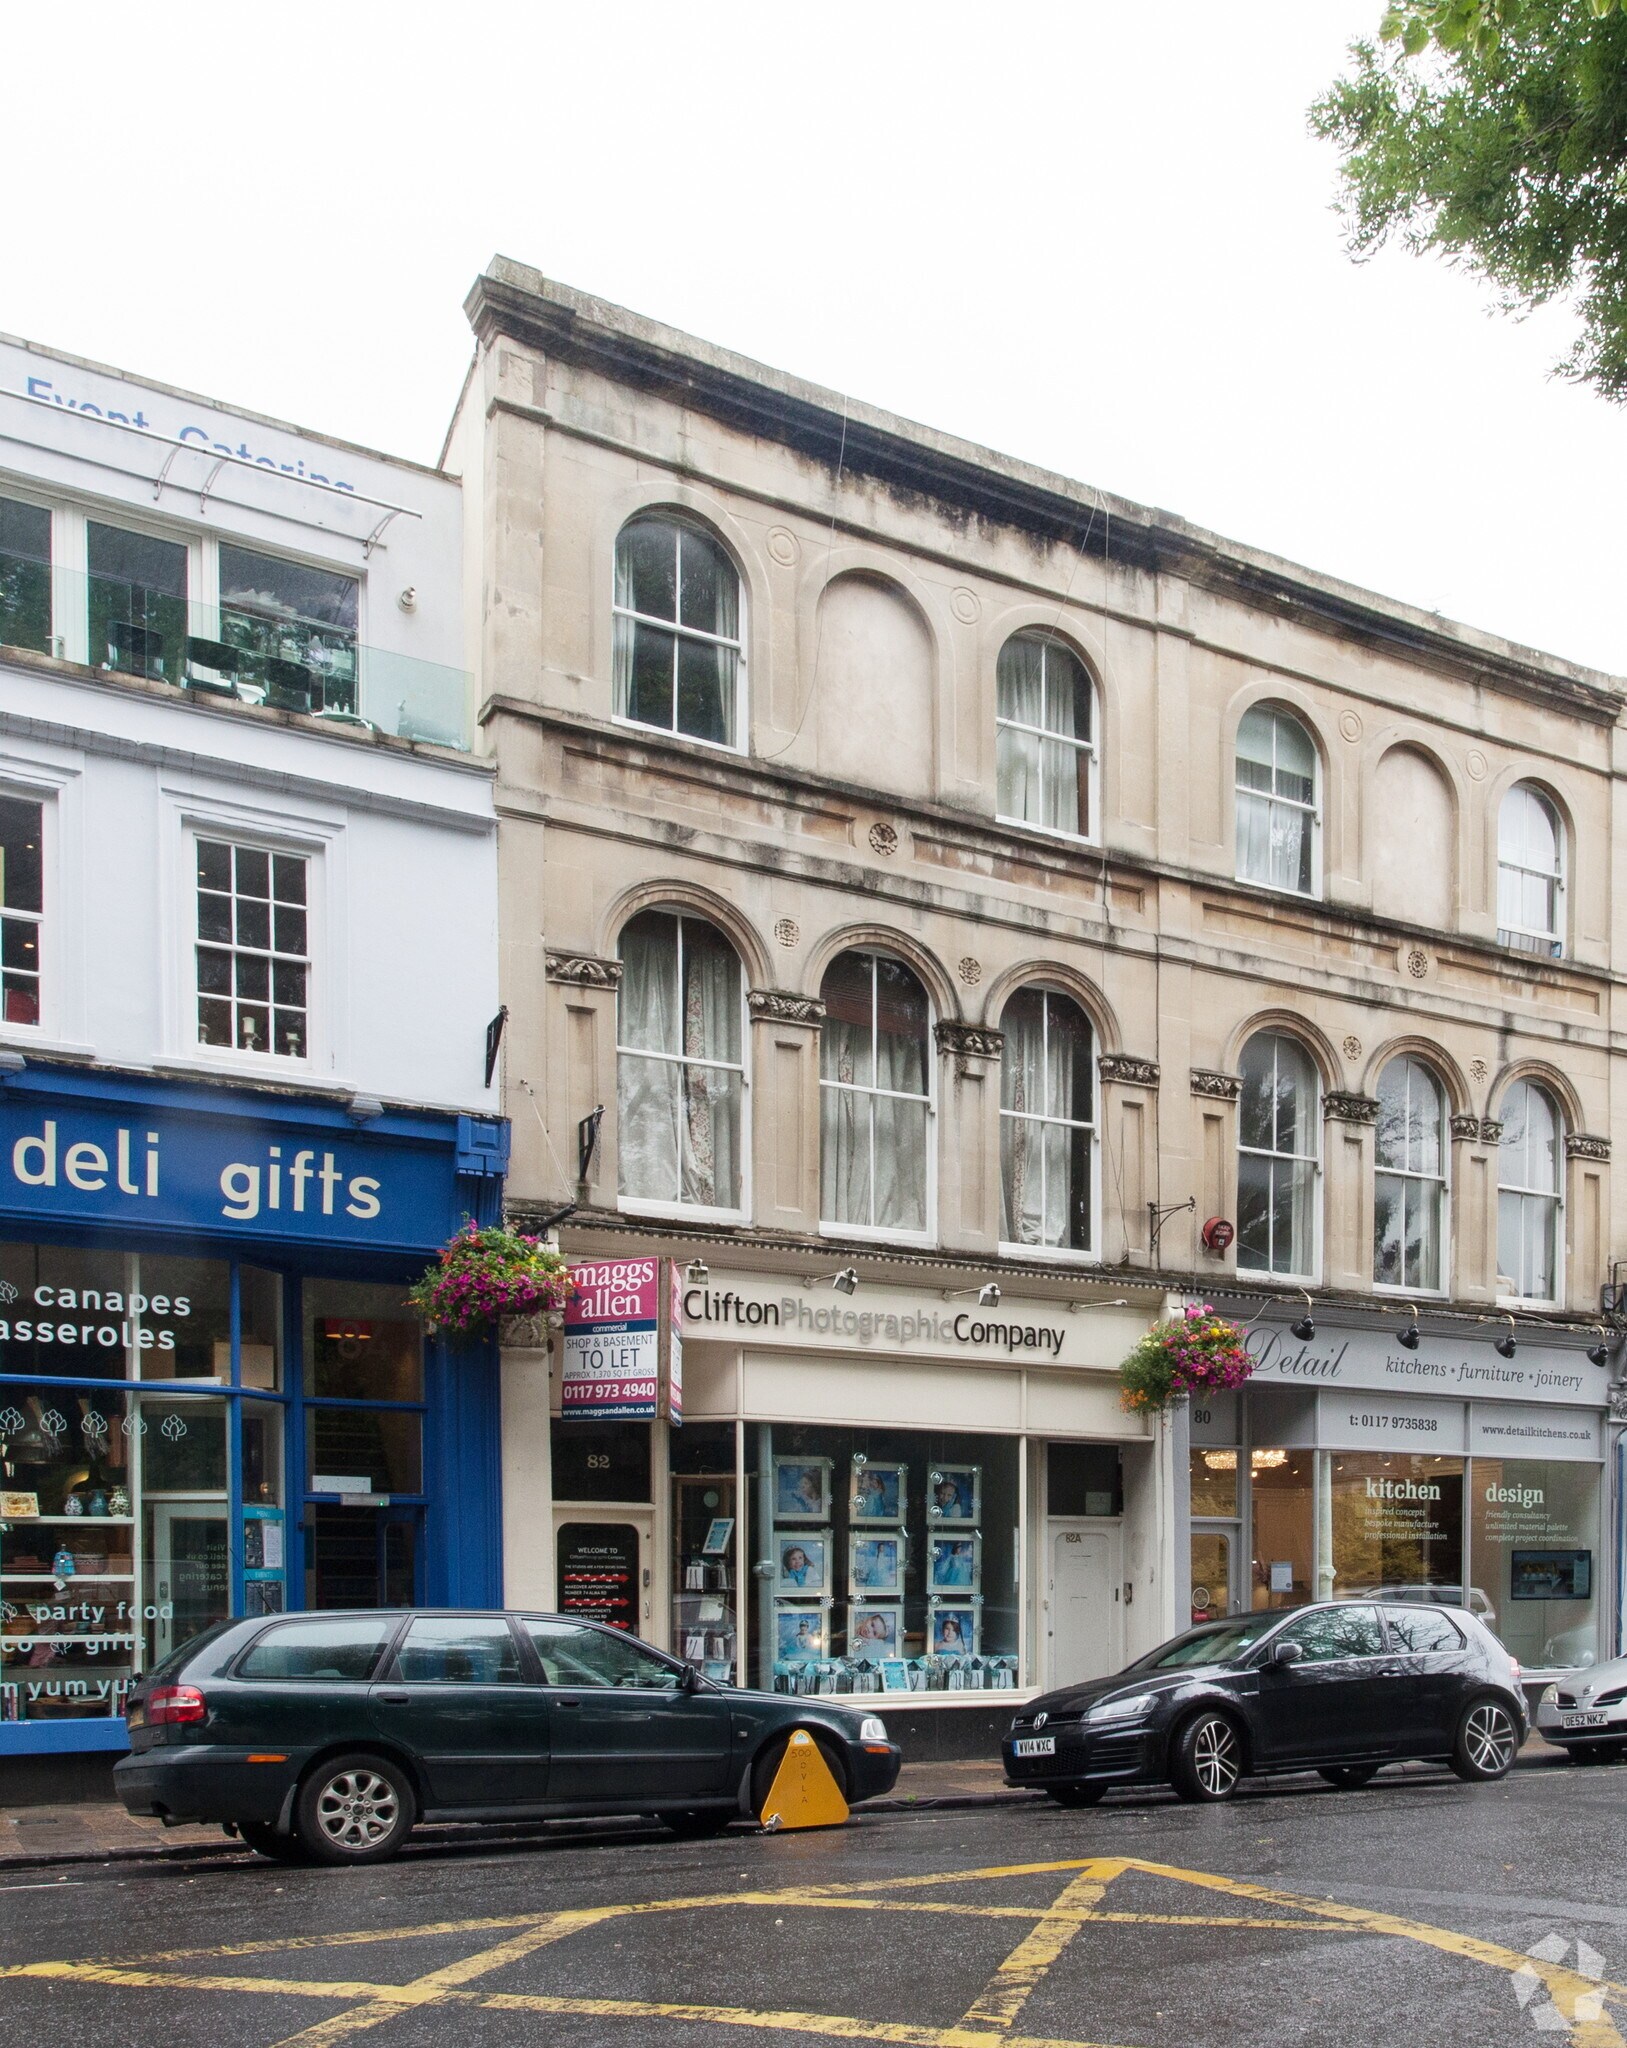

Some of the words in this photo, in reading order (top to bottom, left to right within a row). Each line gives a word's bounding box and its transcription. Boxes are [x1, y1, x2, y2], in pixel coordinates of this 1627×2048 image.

[12, 1120, 159, 1197] deli
[219, 1146, 382, 1220] gifts
[574, 1262, 654, 1293] maggs
[34, 1285, 191, 1318] canapes
[581, 1290, 642, 1319] allen
[592, 1322, 628, 1333] commercial
[683, 1288, 780, 1326] Clifton
[780, 1296, 953, 1345] Photographic
[953, 1313, 1065, 1357] Company
[566, 1338, 591, 1349] SHOP
[593, 1338, 601, 1347] &
[603, 1334, 653, 1348] BASEMENT
[579, 1350, 604, 1369] TO
[610, 1348, 640, 1368] LET
[1244, 1327, 1349, 1378] Detail
[632, 1368, 655, 1377] GROSS
[1385, 1355, 1447, 1377] kitchens
[1457, 1362, 1524, 1383] furniture
[1534, 1369, 1583, 1392] joinery
[563, 1386, 592, 1400] 0117
[595, 1384, 619, 1398] 973
[622, 1382, 655, 1397] 4940
[563, 1407, 655, 1416] www.maggsandallen.co.uk
[1194, 1409, 1211, 1424] 80
[1361, 1415, 1388, 1428] 0117
[1391, 1417, 1437, 1432] 9735838
[1482, 1425, 1591, 1440] www.detailkitchens.co.uk
[587, 1455, 610, 1468] 82
[1364, 1477, 1441, 1501] kitchen
[1485, 1482, 1544, 1509] design
[1065, 1532, 1082, 1543] 82A
[36, 1601, 105, 1624] party
[116, 1601, 173, 1620] food
[85, 1633, 146, 1655] gifts
[28, 1680, 87, 1701] yum
[97, 1678, 138, 1698] yu
[1565, 1716, 1585, 1727] OE52
[1587, 1714, 1604, 1726] NKZ
[791, 1749, 811, 1758] 500
[1019, 1741, 1034, 1754] WV14
[1036, 1739, 1052, 1752] WXC
